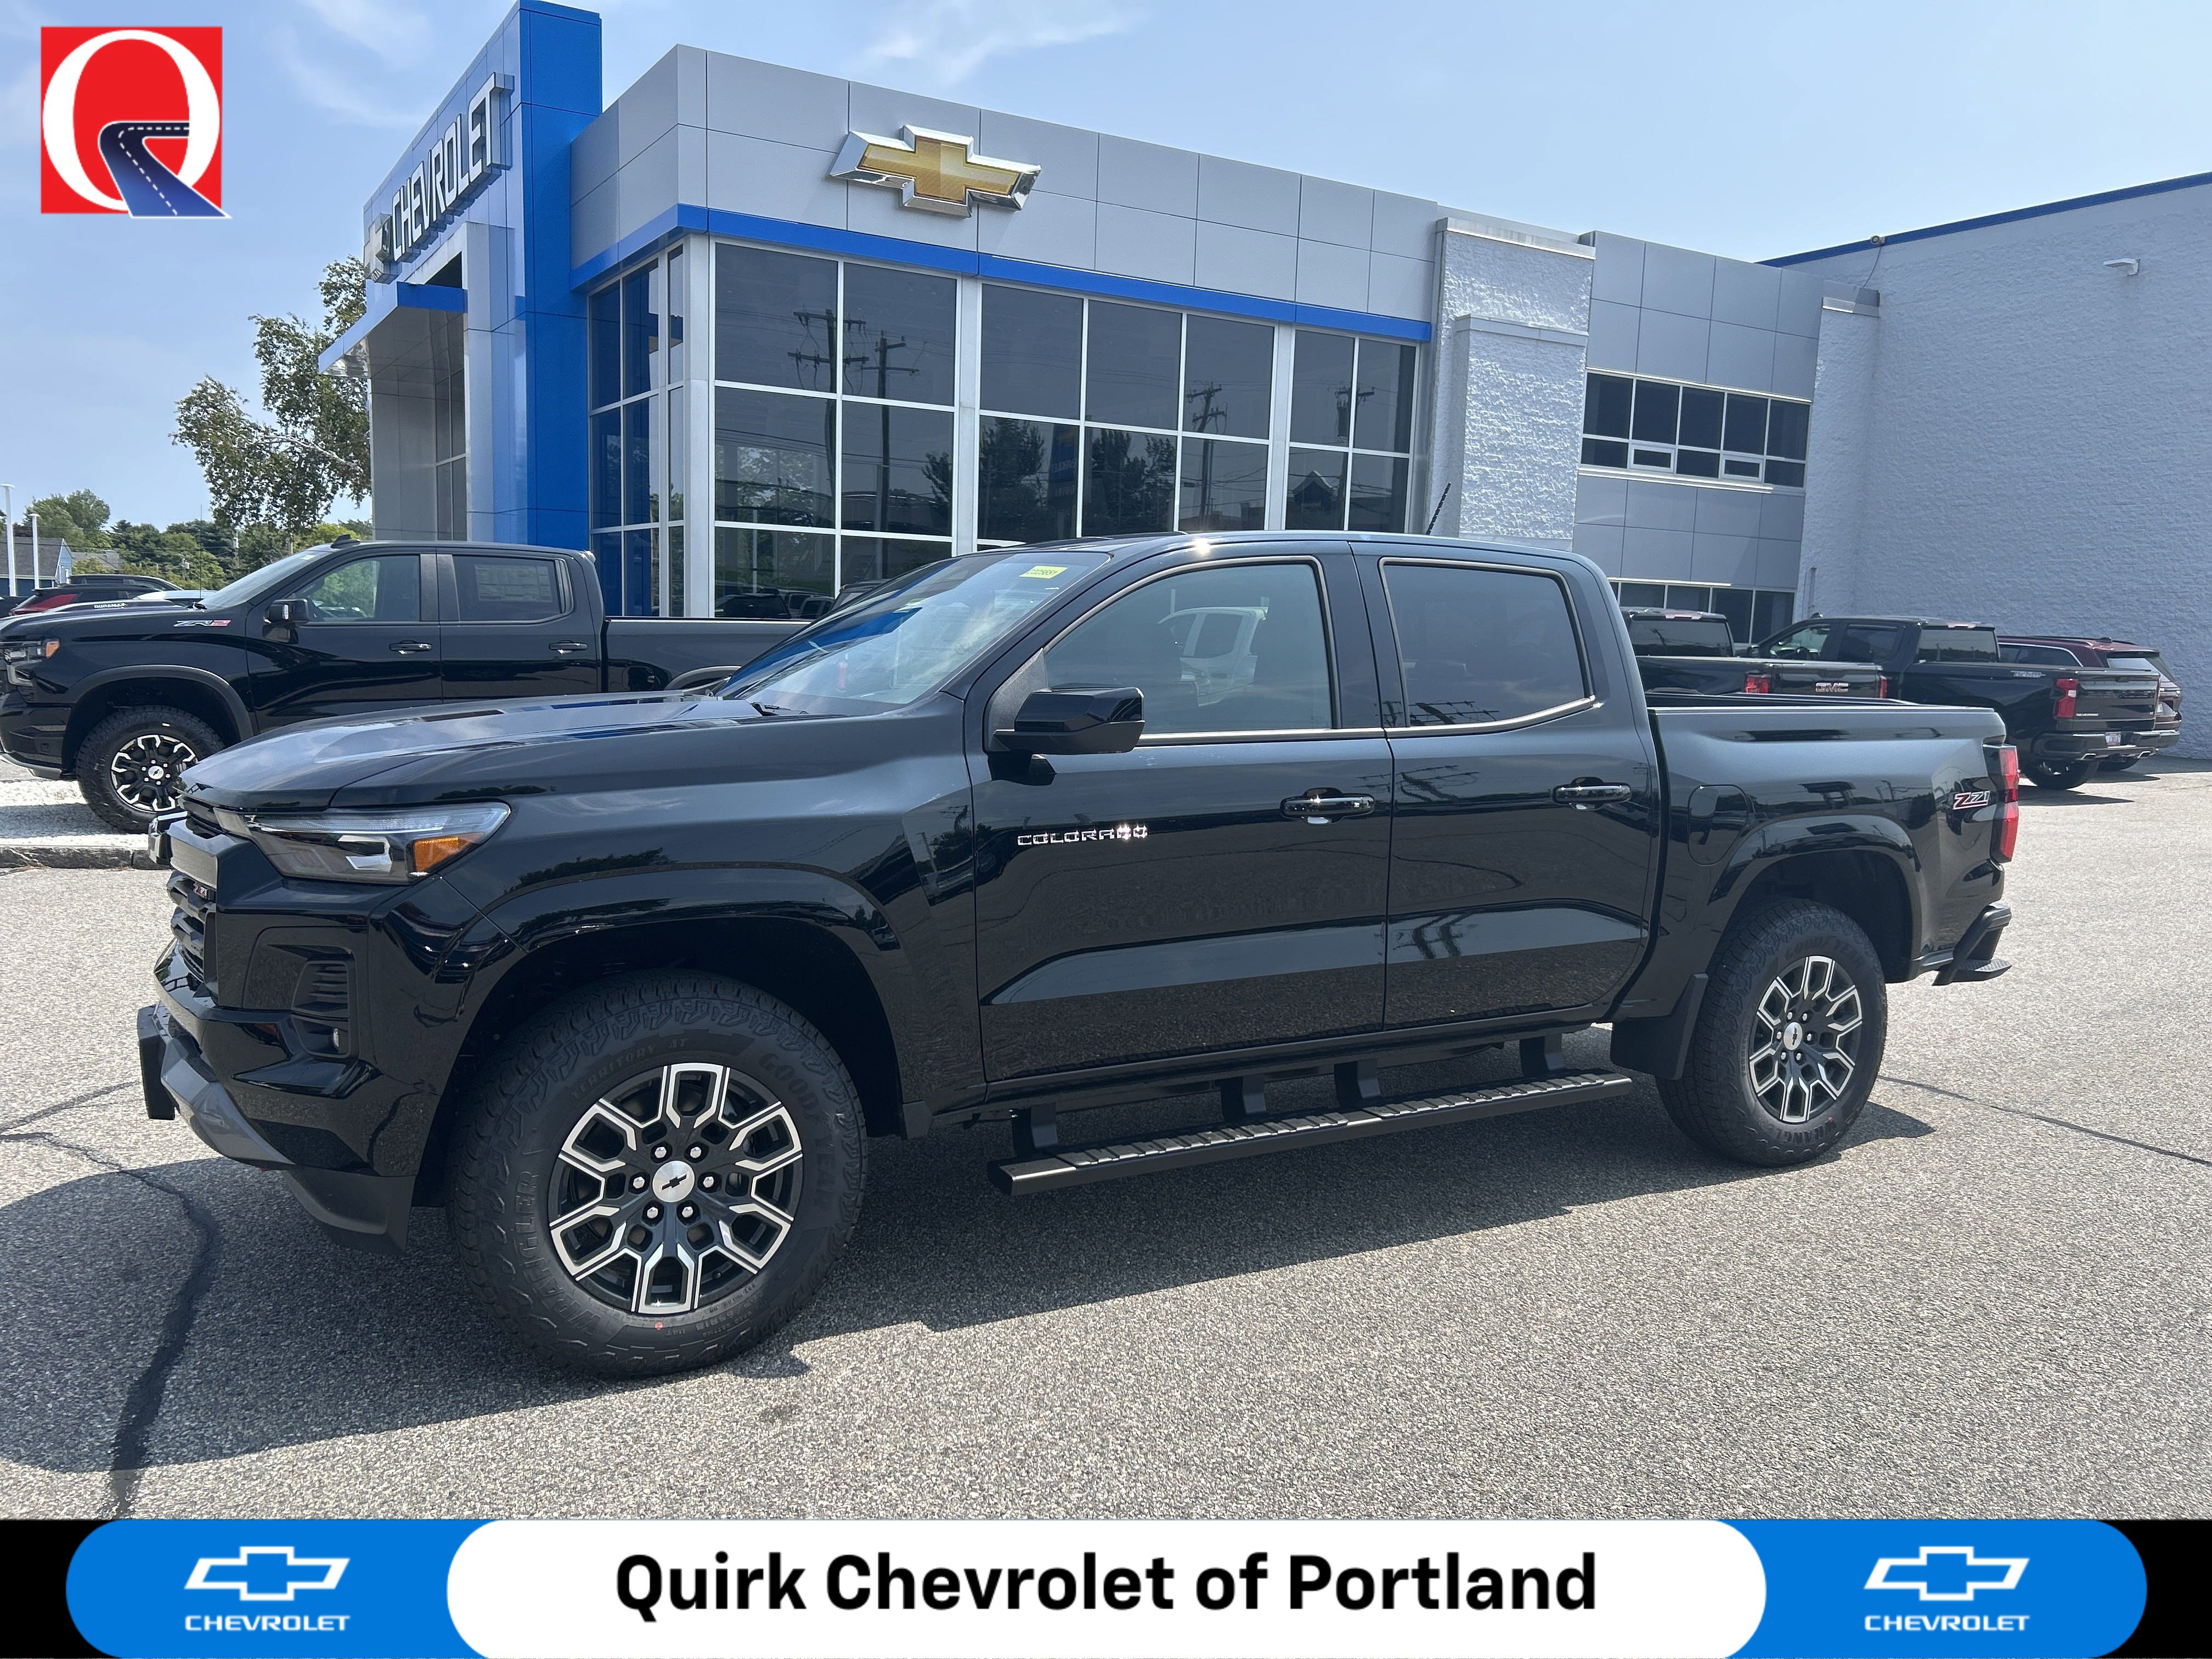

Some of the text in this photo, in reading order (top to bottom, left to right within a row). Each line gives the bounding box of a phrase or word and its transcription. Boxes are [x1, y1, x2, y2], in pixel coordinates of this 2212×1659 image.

[392, 71, 515, 262] CHEVROLET
[1815, 682, 1849, 692] GMC
[1953, 790, 1990, 810] Z71
[1017, 825, 1148, 845] COLORADO
[572, 1038, 689, 1099] TERRITORY AT
[515, 1171, 602, 1336] WRANGLER
